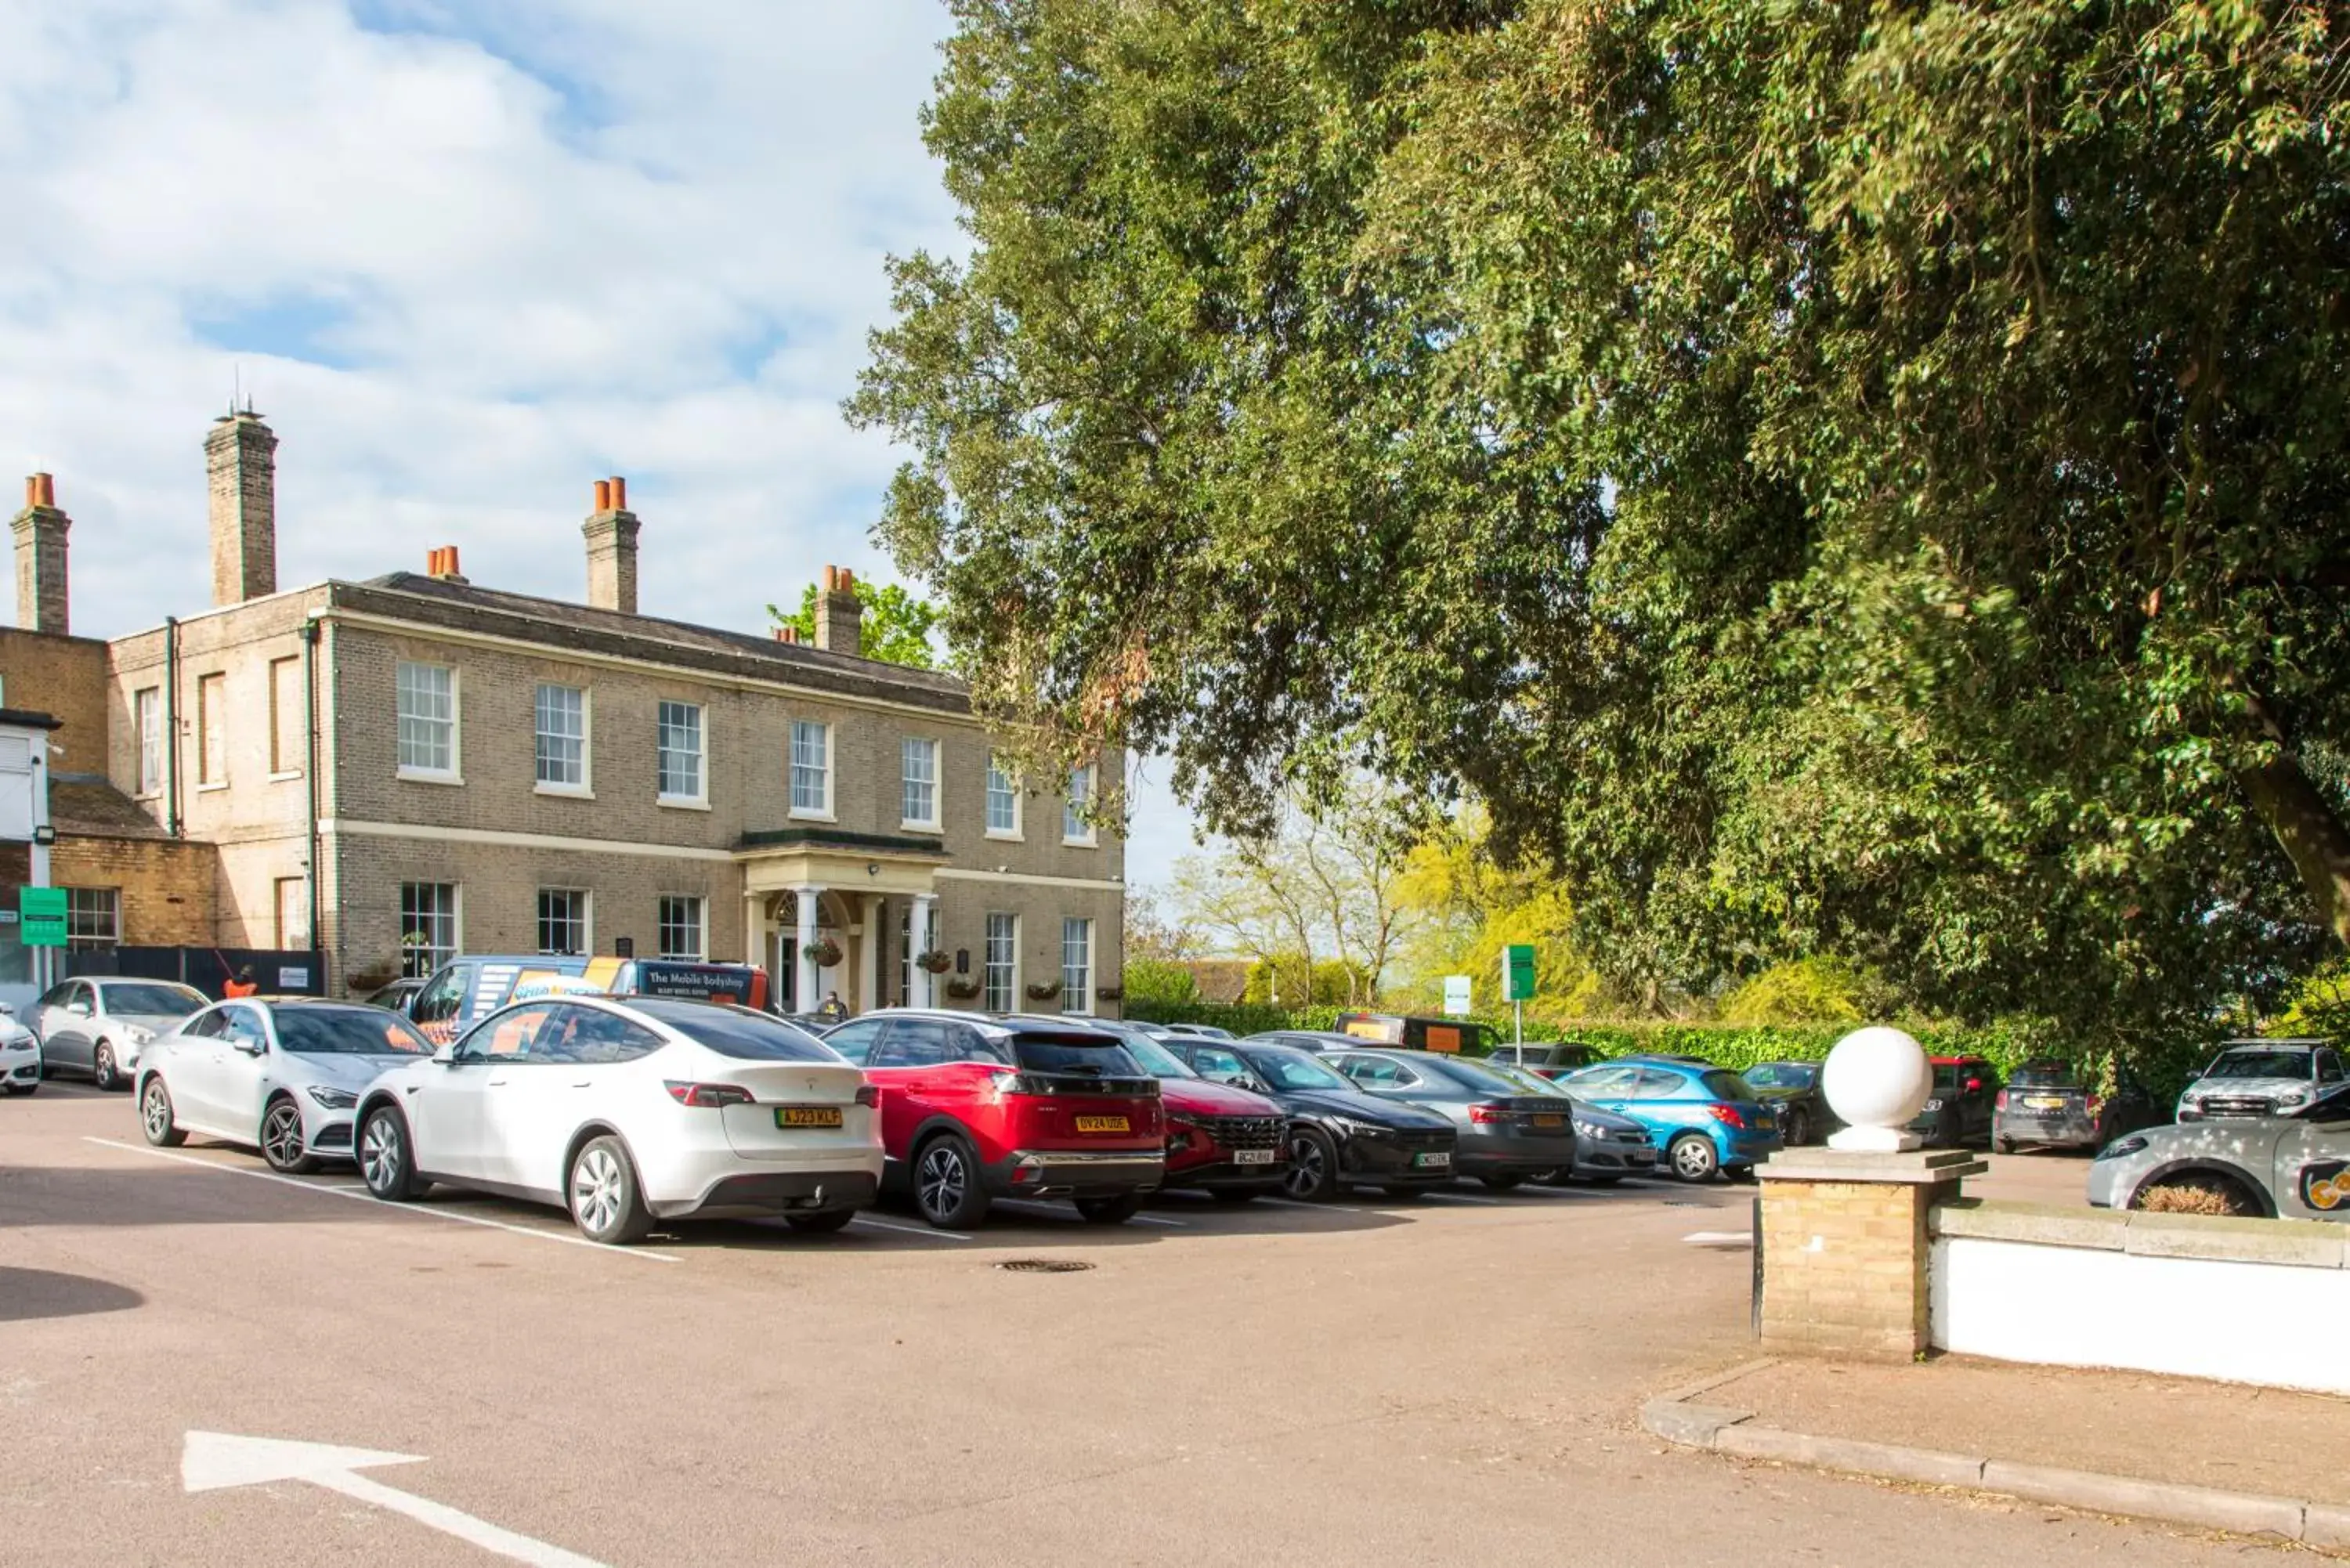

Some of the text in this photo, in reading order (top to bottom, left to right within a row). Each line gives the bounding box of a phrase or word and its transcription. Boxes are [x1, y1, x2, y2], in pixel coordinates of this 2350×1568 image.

[650, 972, 743, 988] The Mobile Bodyshop
[785, 1109, 815, 1123] AJ23
